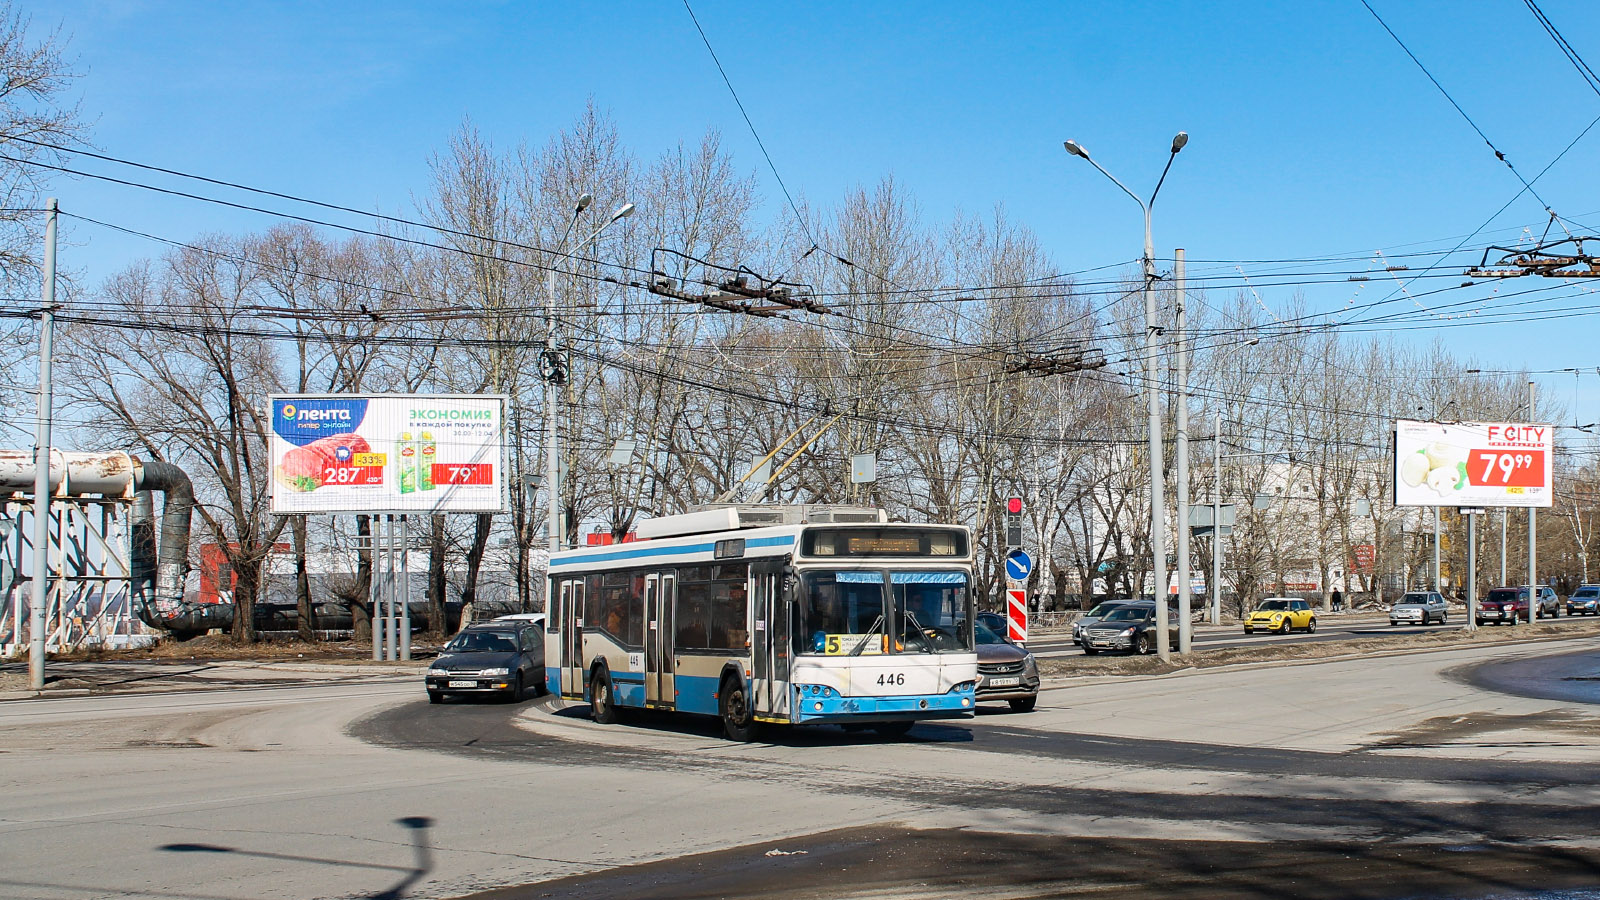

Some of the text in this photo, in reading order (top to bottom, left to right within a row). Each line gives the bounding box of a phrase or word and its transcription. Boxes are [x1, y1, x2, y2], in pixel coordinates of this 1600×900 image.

[298, 409, 351, 420] лента
[409, 410, 492, 420] ЭКОНОМИЯ
[1488, 426, 1545, 442] F CITY
[357, 456, 382, 464] -33%
[828, 636, 840, 653] 5
[877, 673, 905, 686] 446
